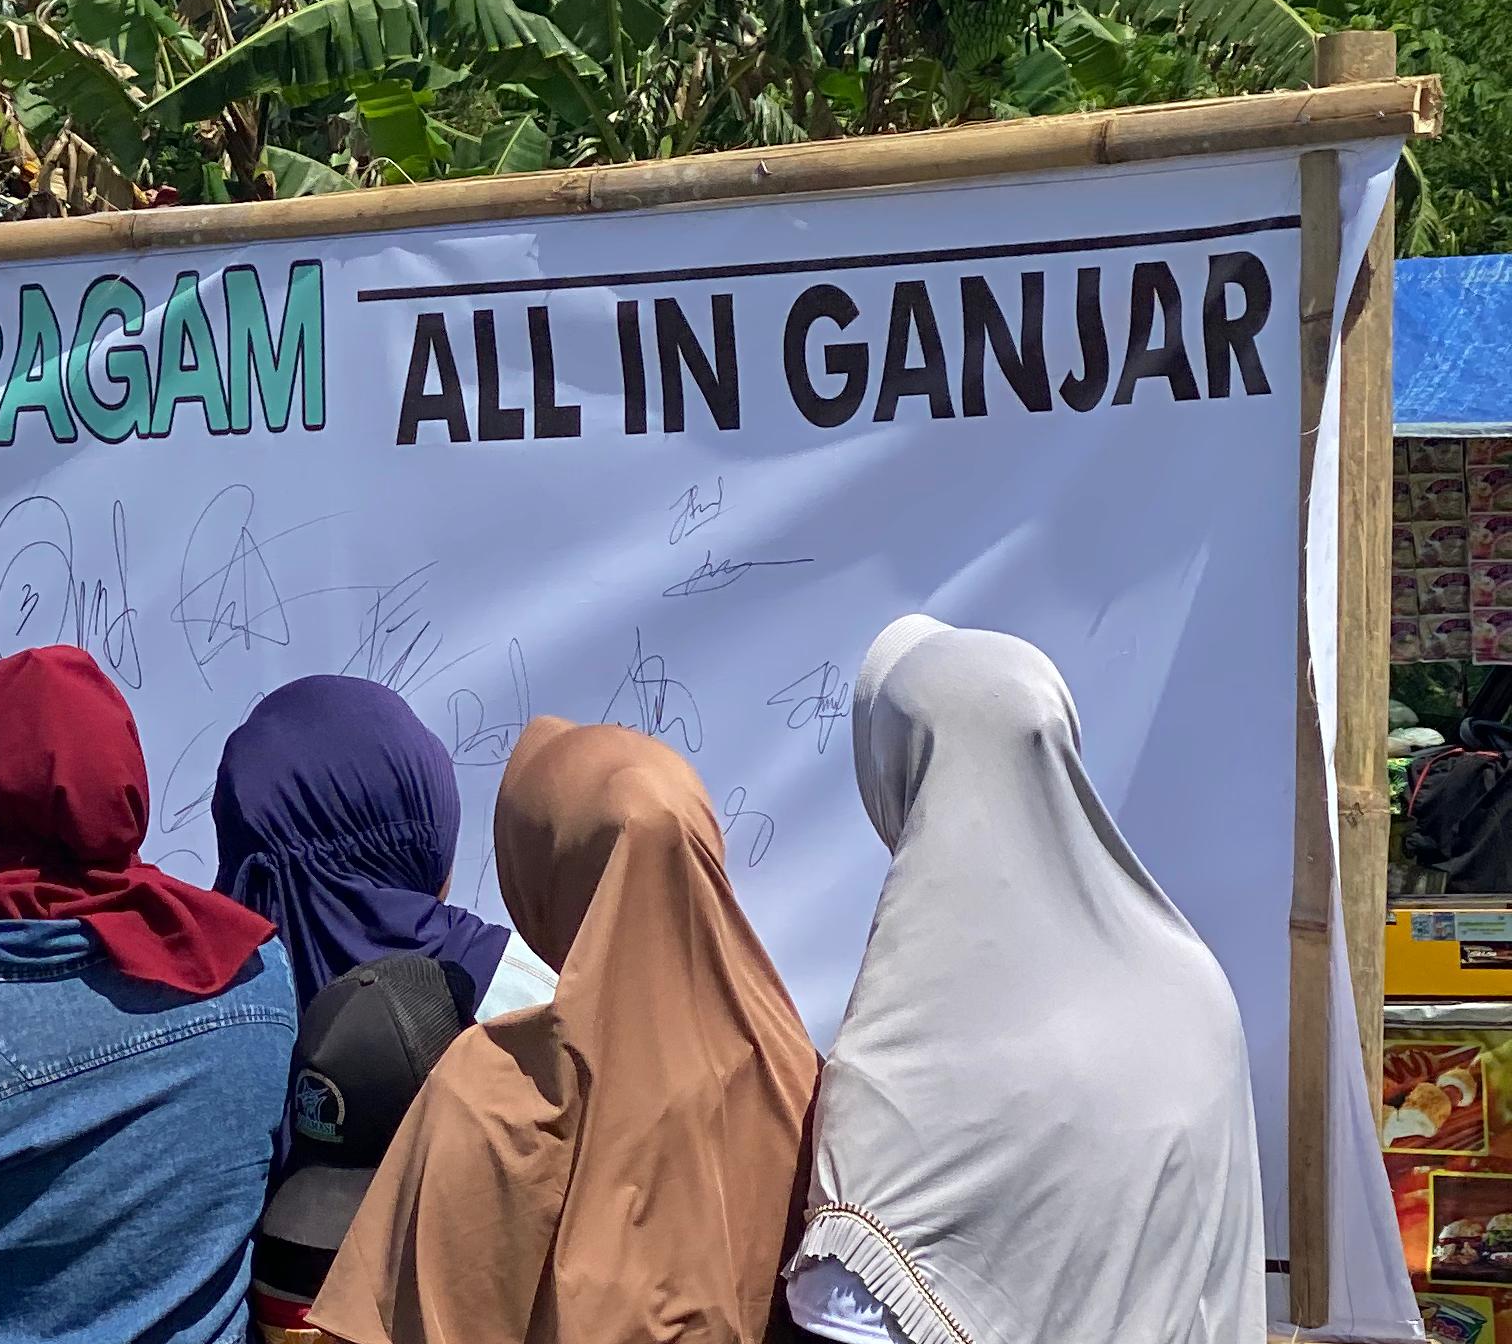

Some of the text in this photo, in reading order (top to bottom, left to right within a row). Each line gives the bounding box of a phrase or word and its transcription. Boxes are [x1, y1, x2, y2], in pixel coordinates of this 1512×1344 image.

[396, 306, 582, 446] ALL
[618, 293, 741, 435] IN
[783, 251, 1273, 429] GANJAR
